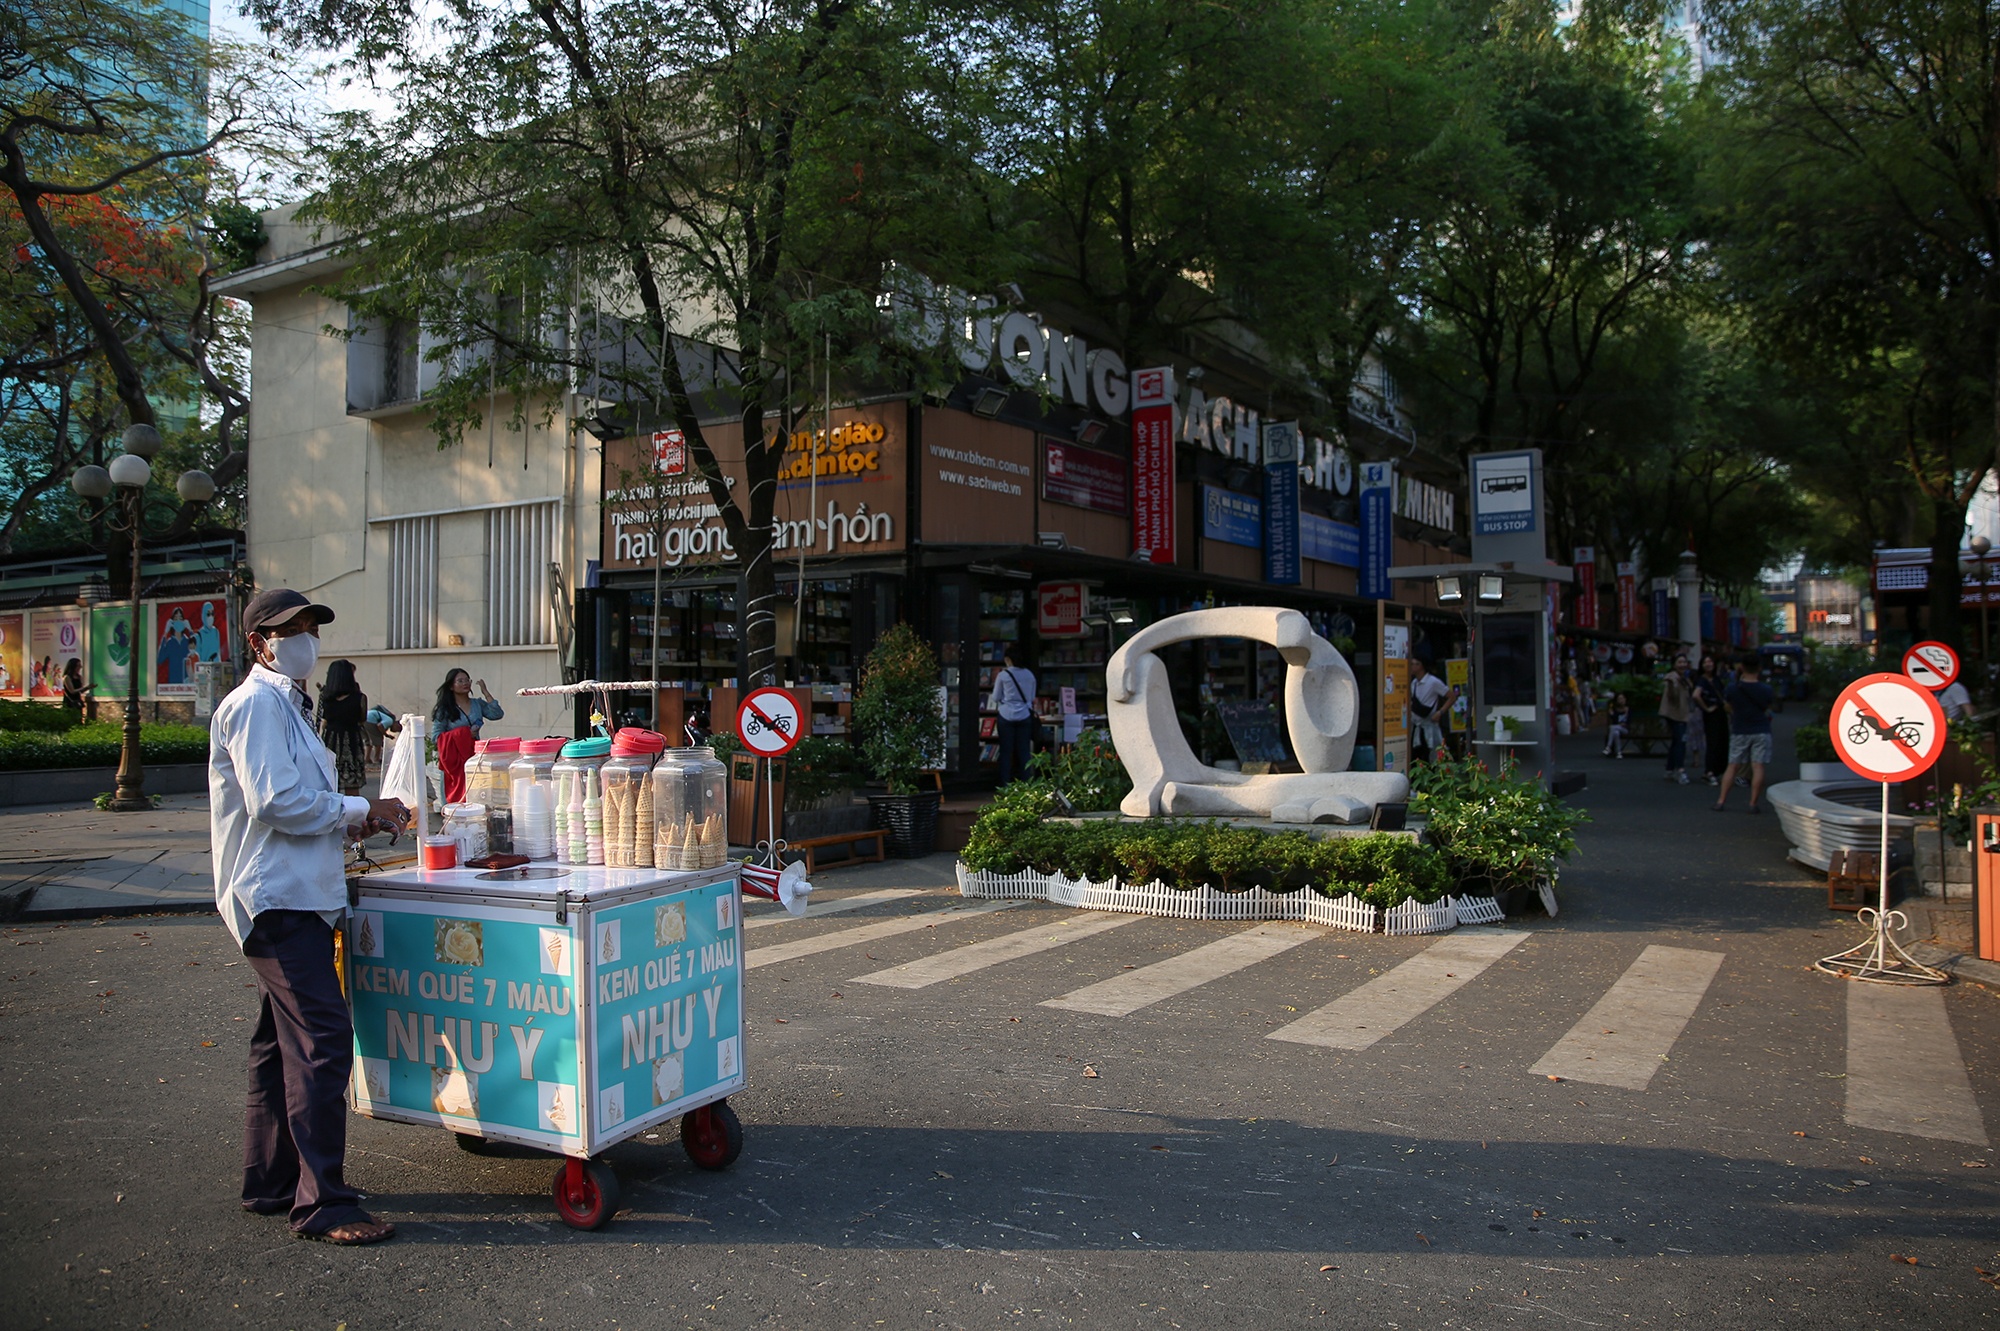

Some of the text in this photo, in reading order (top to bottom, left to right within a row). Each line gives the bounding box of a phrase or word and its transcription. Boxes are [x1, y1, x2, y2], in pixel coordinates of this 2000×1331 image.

[929, 444, 1030, 477] www.nxbhcm.com.vn
[1134, 421, 1148, 551] NHÀ XUẤT BẢN TỔNG HỢP
[1149, 421, 1160, 549] THÀNH PHỐ HỒ CHÍ MINH
[702, 503, 721, 518] MIN
[1269, 495, 1283, 519] BẢN
[1405, 476, 1454, 531] MINH
[1483, 520, 1528, 532] BUS STOP
[615, 521, 658, 566] hạt
[771, 515, 812, 549] âm
[828, 500, 893, 552] hồn
[1268, 521, 1284, 551] XUẤT
[1269, 553, 1284, 579] NHÀ
[763, 673, 776, 686] 30
[355, 964, 571, 1016] KEM QUẾ 7 MÀU
[599, 936, 735, 1006] KEM QUẾ 7 MÀU
[385, 1009, 545, 1081] NHƯ Ý
[621, 975, 723, 1071] NHƯ Ý
